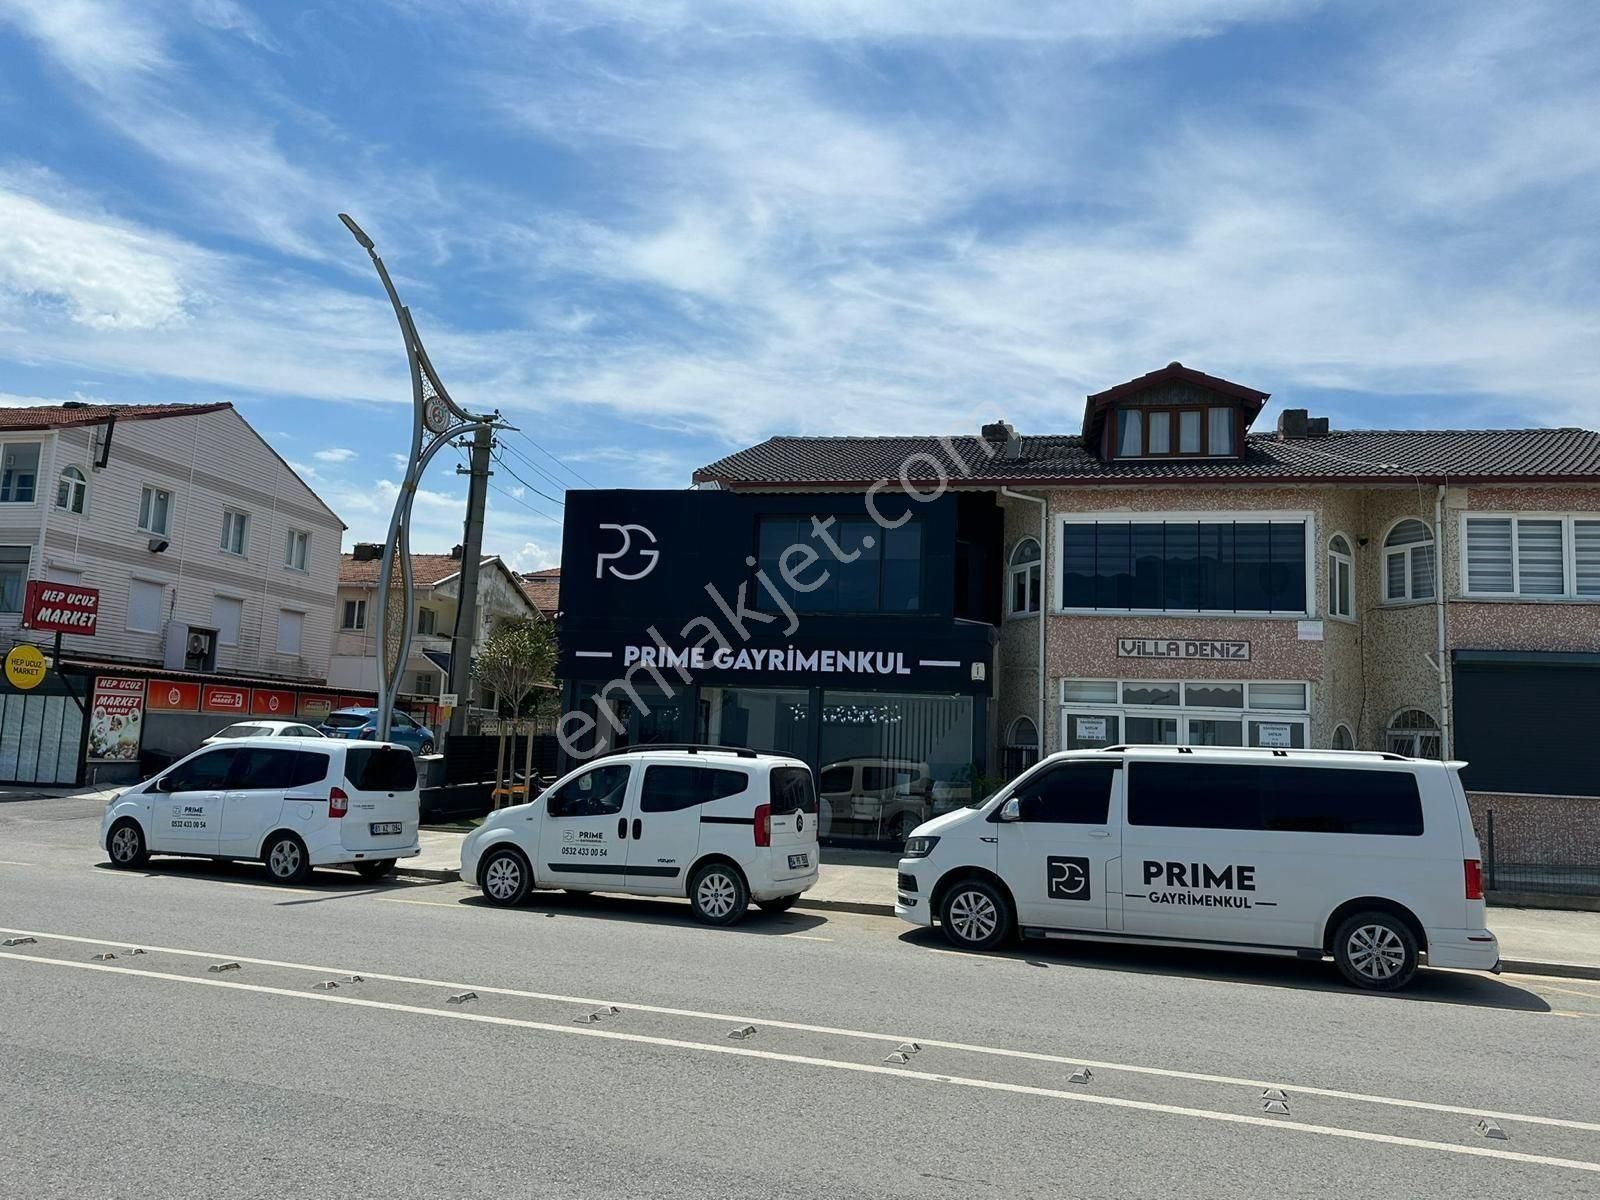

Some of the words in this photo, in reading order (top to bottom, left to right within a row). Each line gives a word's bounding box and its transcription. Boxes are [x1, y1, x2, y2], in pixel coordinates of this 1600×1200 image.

[42, 590, 65, 602] HEP
[67, 593, 96, 607] UCUZ
[37, 607, 96, 627] MARKET
[11, 658, 25, 666] HEP
[25, 660, 42, 668] UCUZ
[623, 645, 705, 669] PRIME
[712, 644, 911, 675] GAYRİMENKUL
[13, 666, 39, 676] MARKET
[100, 679, 118, 688] HEP
[119, 681, 142, 690] UCUZ
[97, 695, 140, 707] MARKET
[184, 806, 203, 814] PRIME
[579, 831, 603, 840] PRIME
[561, 846, 577, 856] 0532
[577, 847, 590, 857] 433
[590, 848, 599, 857] 00
[599, 848, 608, 857] 54
[1143, 860, 1256, 891] PRIME
[1149, 891, 1252, 909] GAYRİMENKUL
